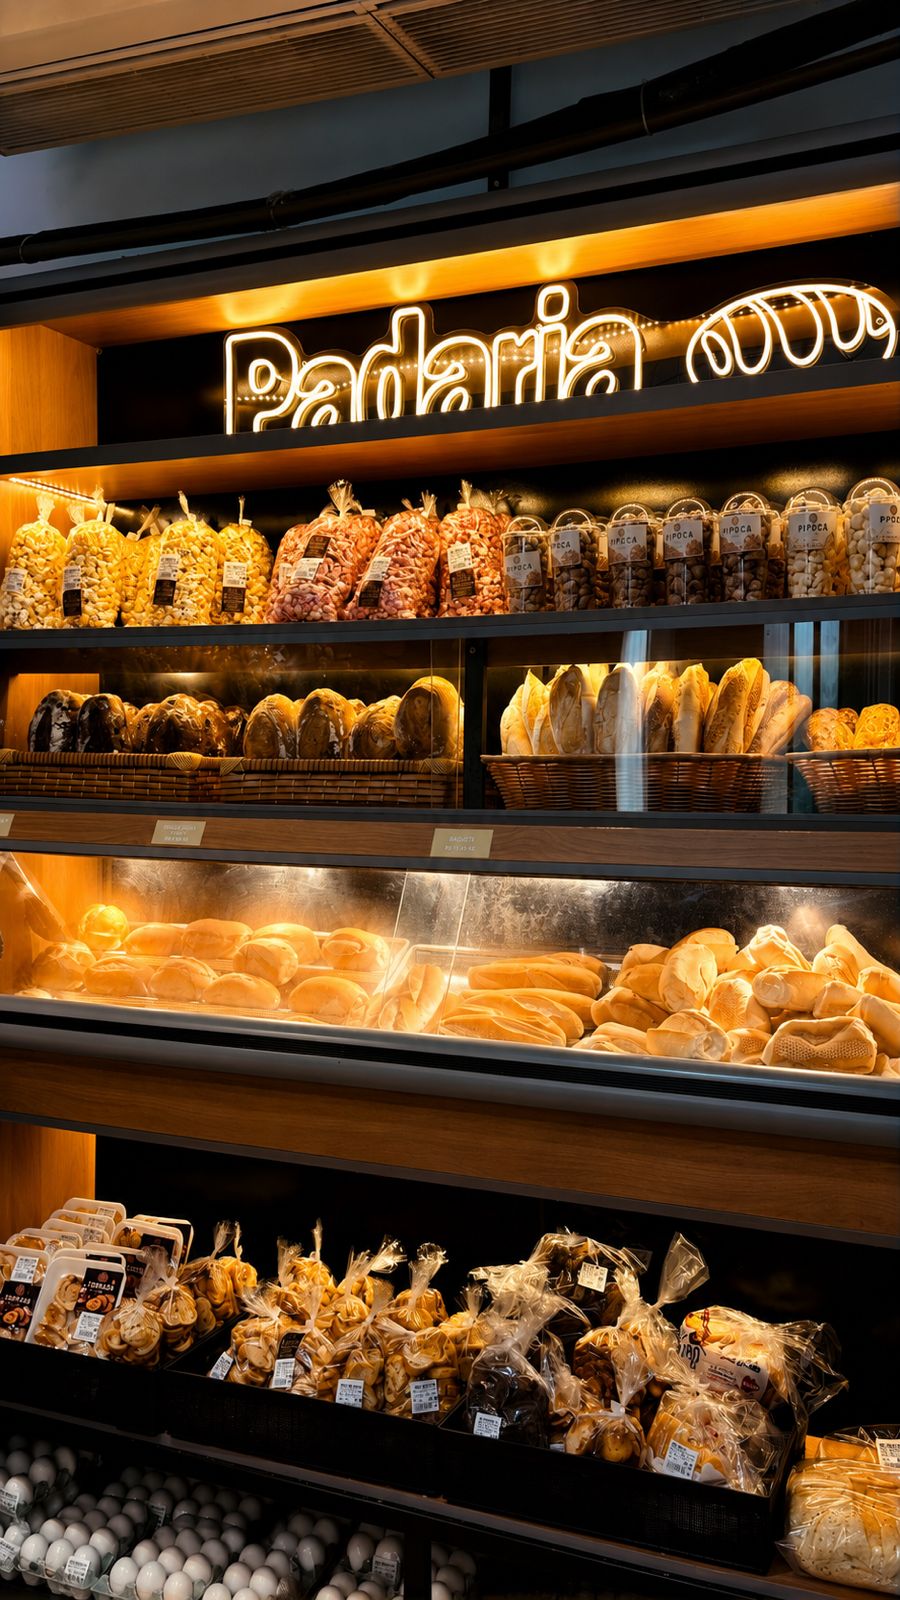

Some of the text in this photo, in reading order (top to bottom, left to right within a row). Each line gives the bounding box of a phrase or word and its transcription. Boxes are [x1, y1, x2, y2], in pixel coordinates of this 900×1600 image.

[225, 284, 642, 434] Padaria
[723, 524, 752, 534] PIPOCA
[798, 522, 828, 532] PIPOCA
[666, 530, 694, 541] PIPOCA
[610, 536, 637, 546] PIPOCA
[507, 562, 533, 572] PIPOCA
